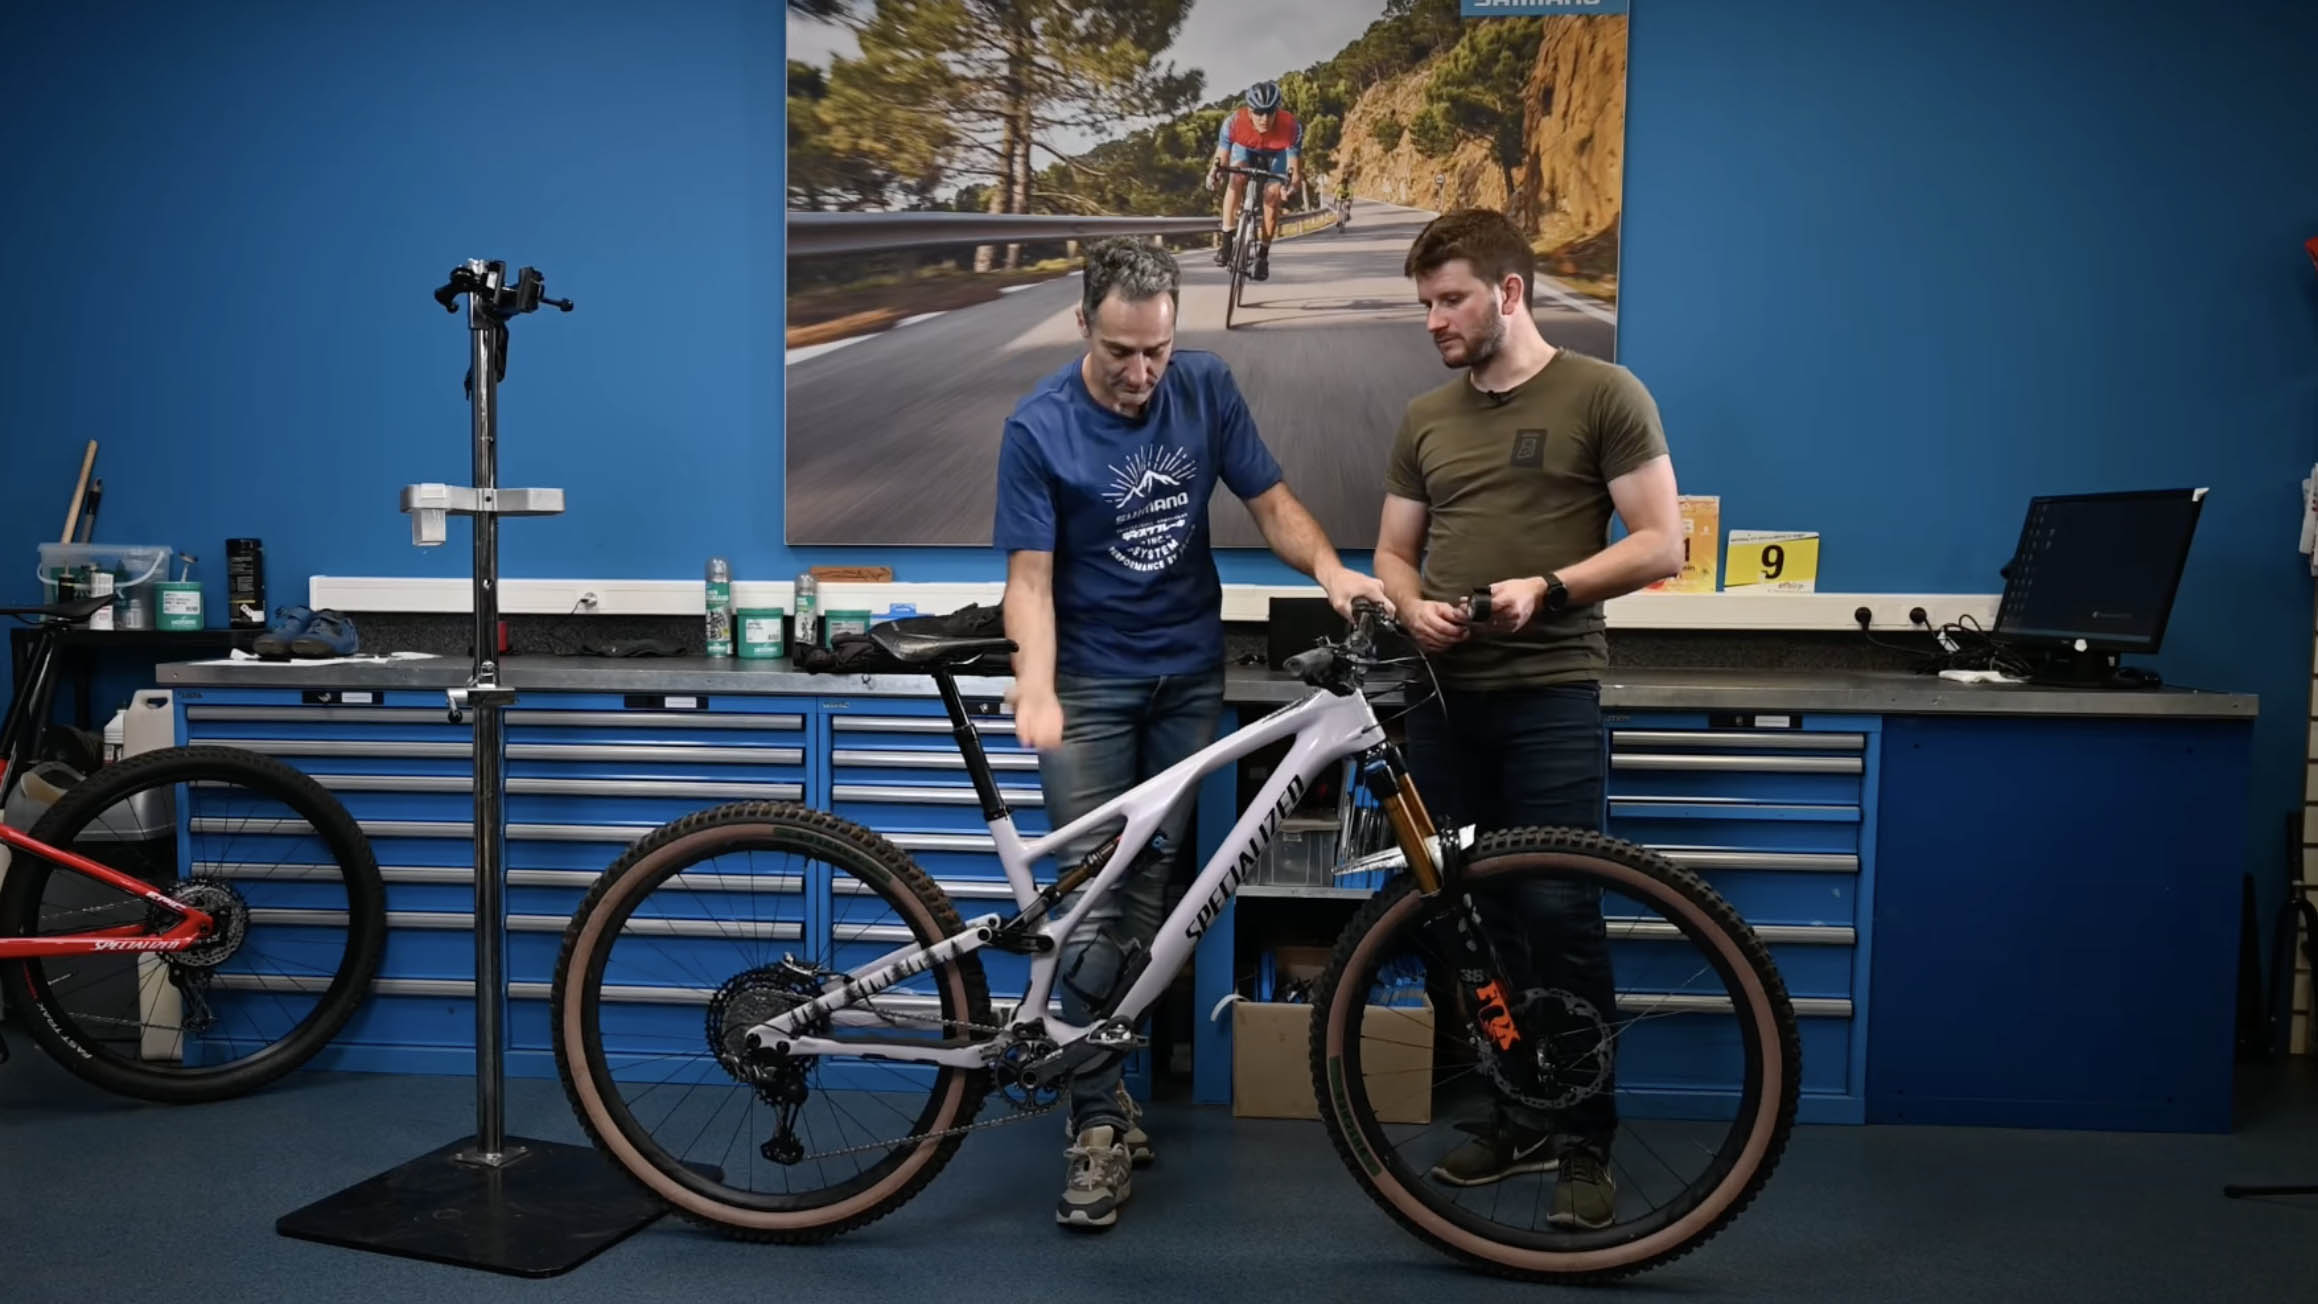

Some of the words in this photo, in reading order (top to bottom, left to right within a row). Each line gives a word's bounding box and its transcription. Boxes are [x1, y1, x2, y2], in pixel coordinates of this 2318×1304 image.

[1132, 539, 1178, 560] SYSTEM
[1761, 545, 1784, 579] 9
[1185, 774, 1304, 940] SPECIALIZED
[95, 940, 181, 950] SPECIALIZED
[1475, 978, 1520, 1050] FOX
